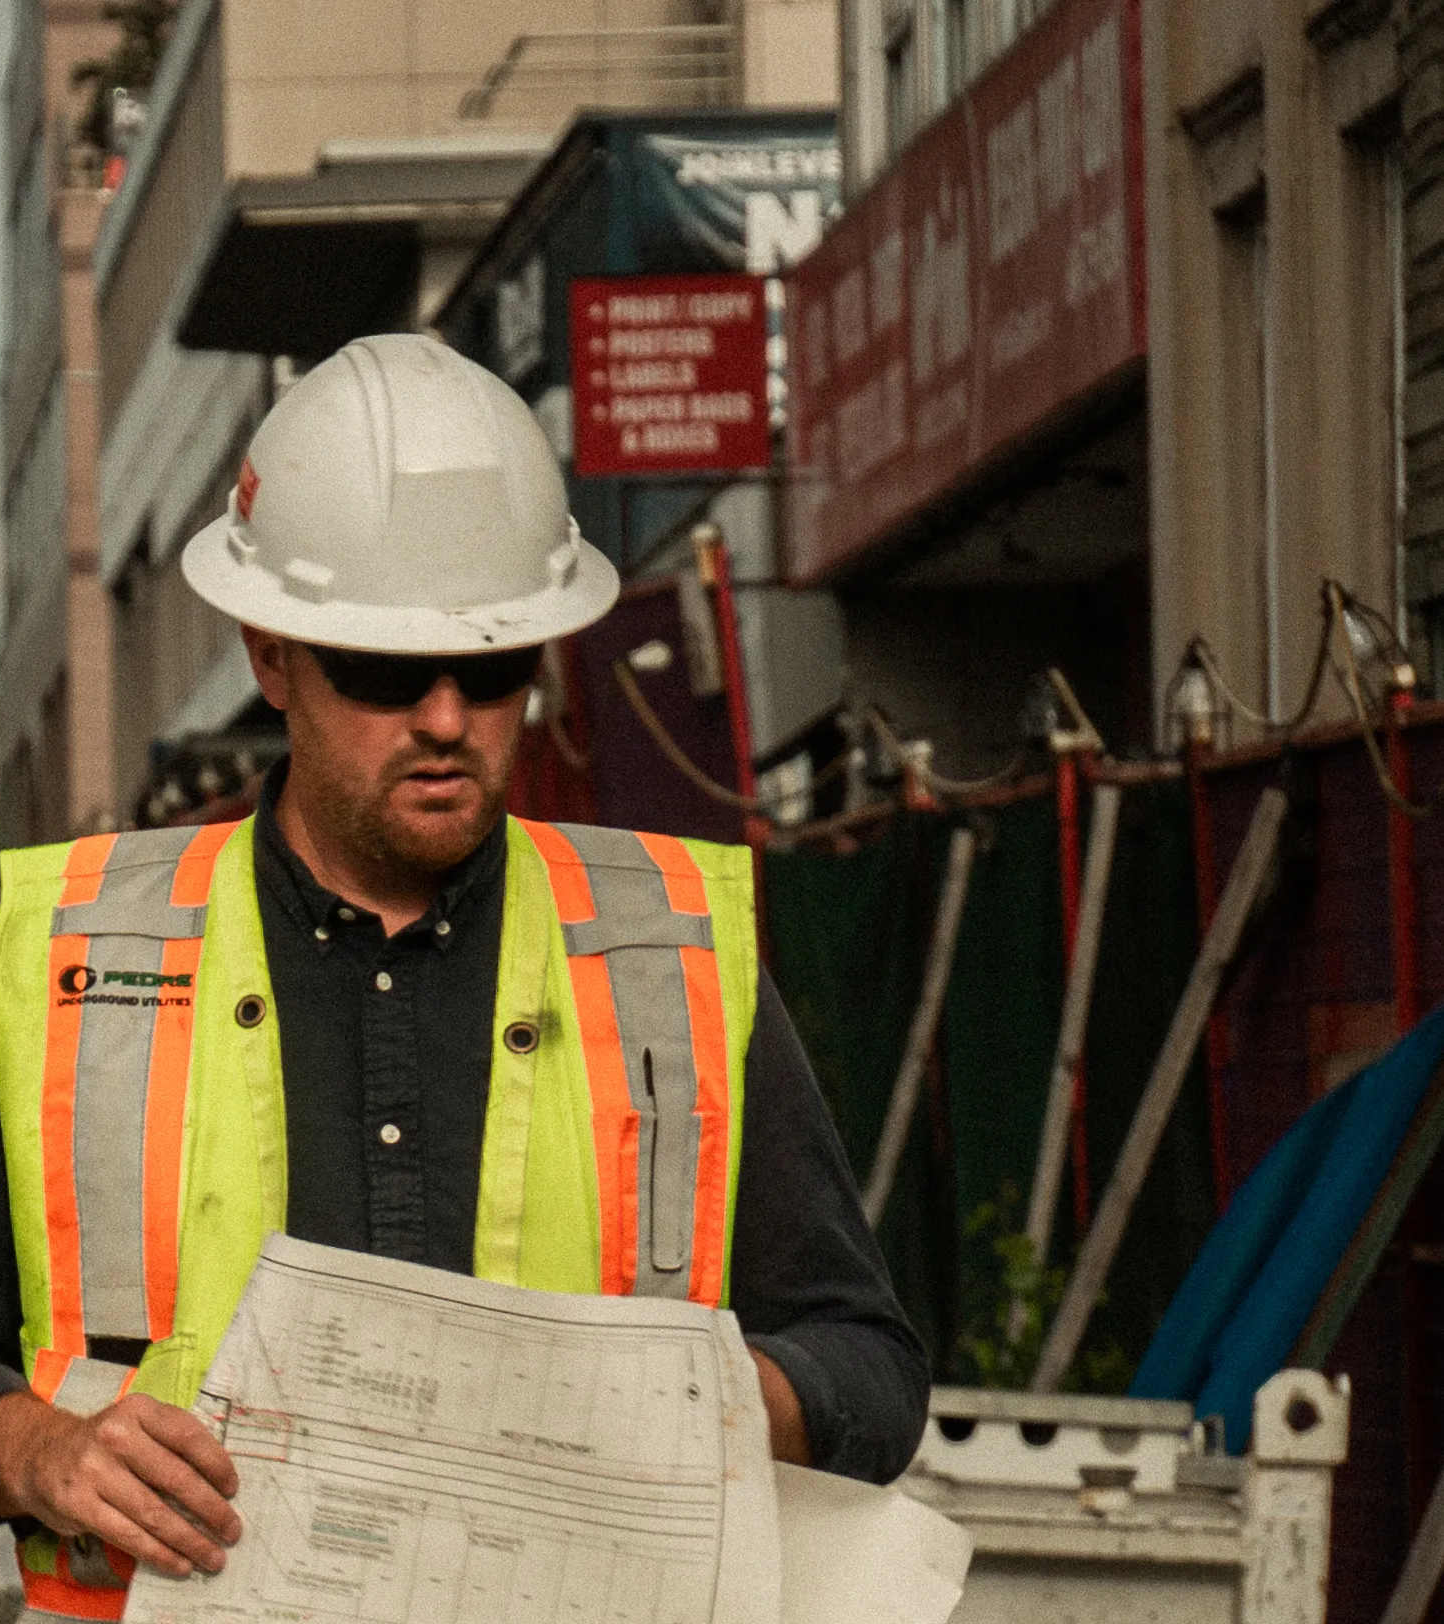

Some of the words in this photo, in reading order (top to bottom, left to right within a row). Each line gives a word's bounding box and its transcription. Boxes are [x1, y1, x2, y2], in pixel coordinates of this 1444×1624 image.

[608, 328, 713, 356] POSTERS
[609, 361, 698, 390] LABELS
[610, 394, 685, 422] PAPER
[689, 391, 753, 422] BAGS
[642, 421, 719, 451] BOXES
[57, 994, 140, 1007] UNDERGROUND
[141, 996, 191, 1008] UTILITIES
